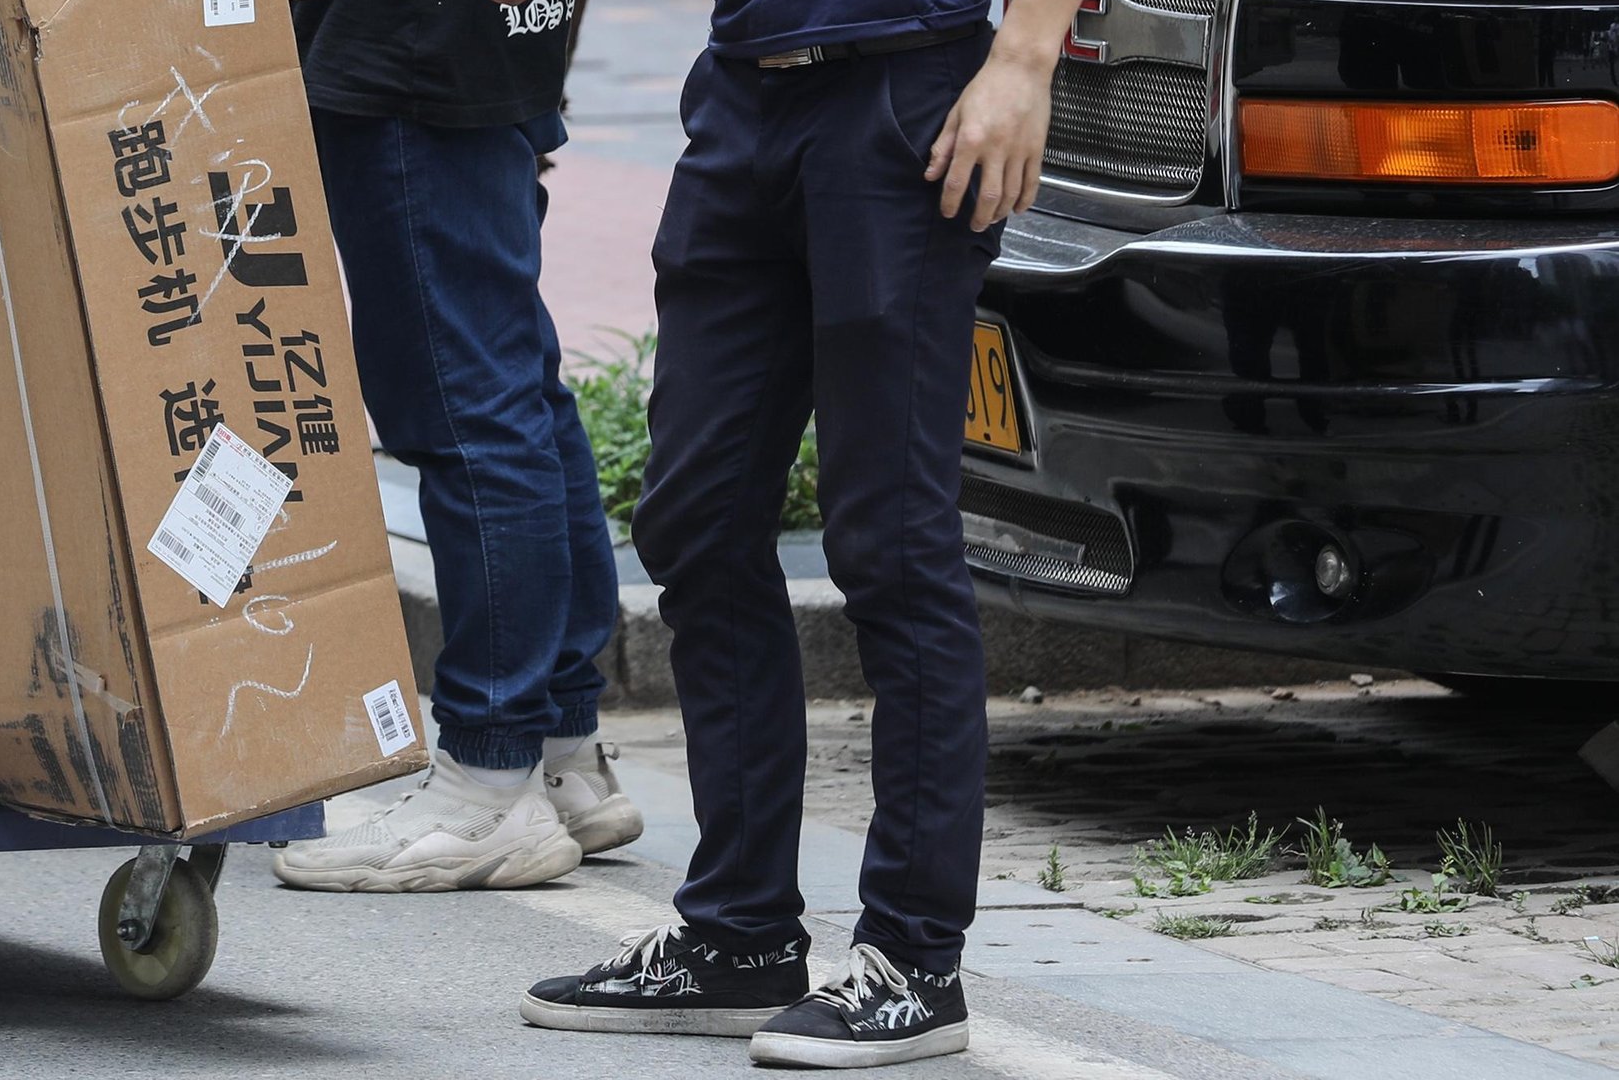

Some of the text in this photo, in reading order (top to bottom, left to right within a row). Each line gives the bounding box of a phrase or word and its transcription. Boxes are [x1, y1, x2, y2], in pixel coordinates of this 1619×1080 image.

[106, 119, 204, 348] 跑步机
[281, 328, 340, 457] 亿健
